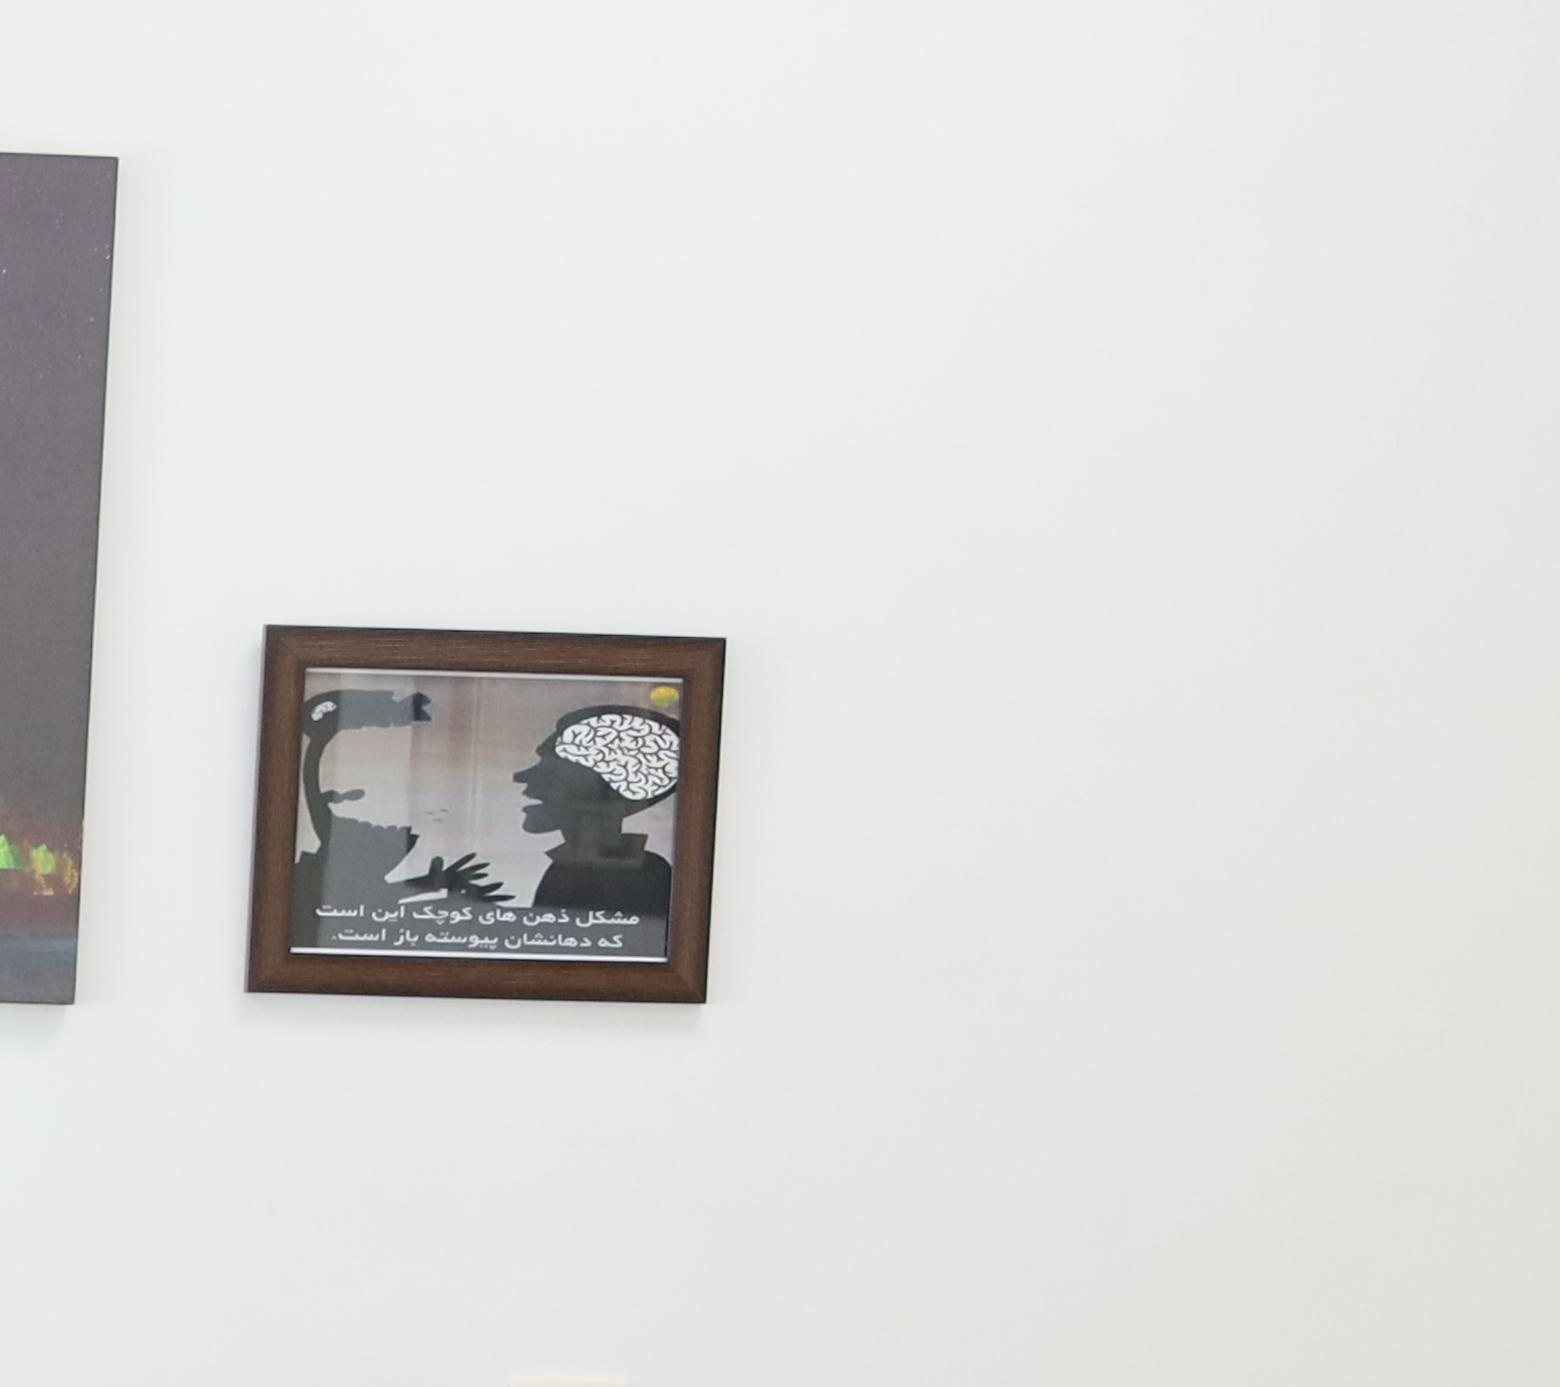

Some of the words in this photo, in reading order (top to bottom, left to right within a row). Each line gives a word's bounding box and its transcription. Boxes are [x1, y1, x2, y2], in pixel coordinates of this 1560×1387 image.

[315, 904, 365, 917] است
[371, 905, 405, 922] این
[412, 905, 472, 925] کوچک
[478, 908, 517, 925] های
[523, 908, 570, 926] ذهن
[575, 910, 640, 928] مشکل
[393, 928, 419, 947] باز
[424, 931, 499, 950] پیوسته
[504, 932, 592, 949] دهانشان
[597, 934, 623, 948] که
